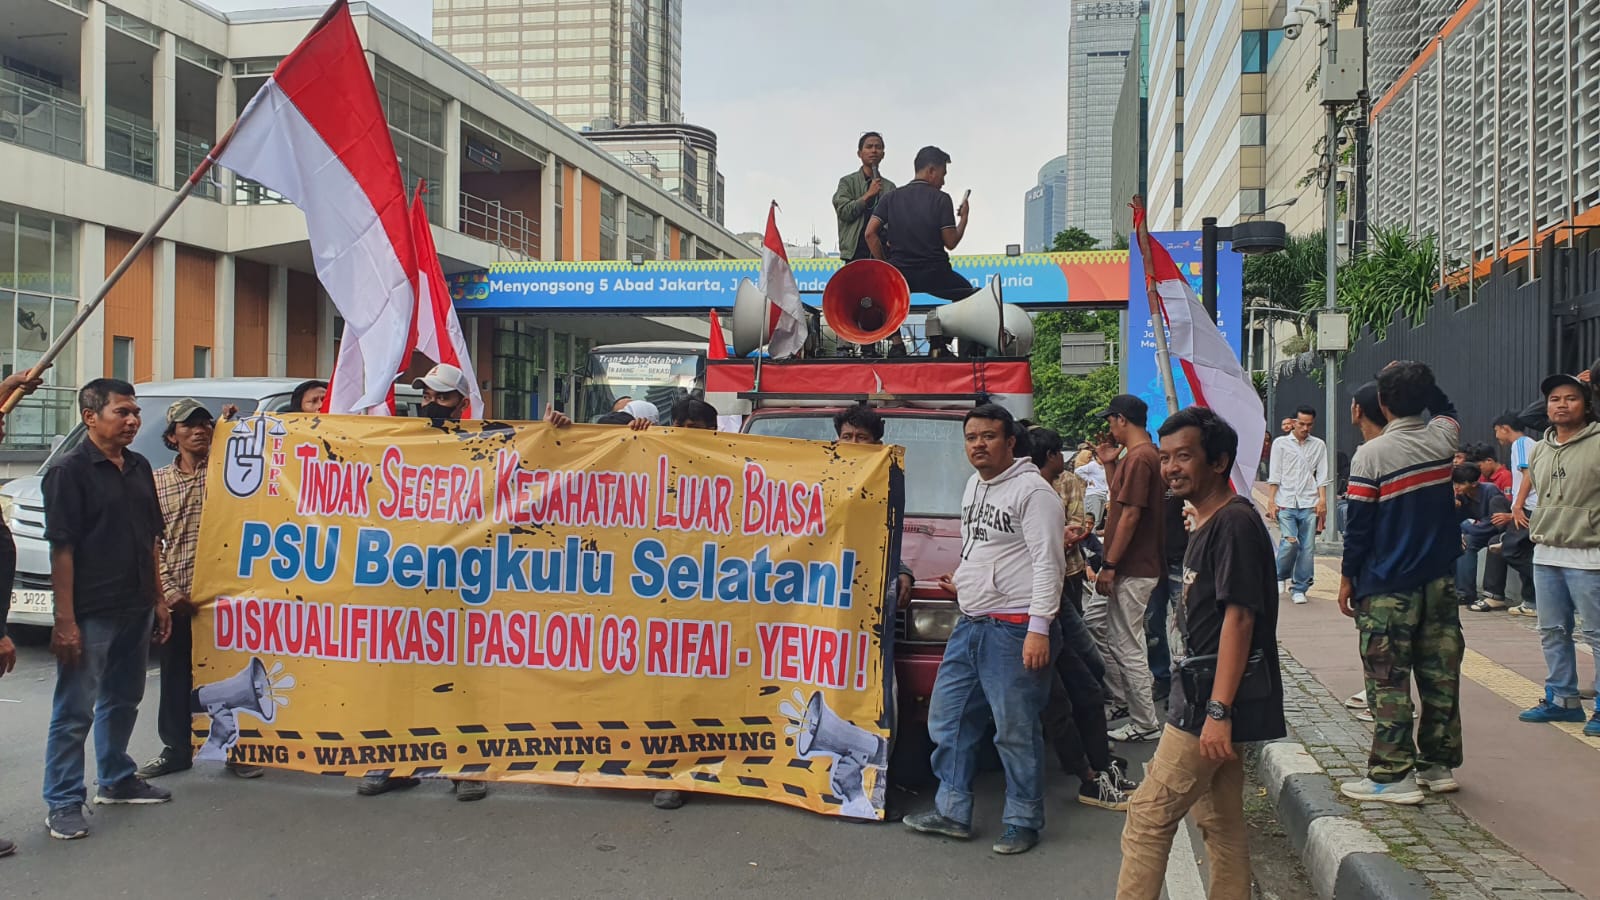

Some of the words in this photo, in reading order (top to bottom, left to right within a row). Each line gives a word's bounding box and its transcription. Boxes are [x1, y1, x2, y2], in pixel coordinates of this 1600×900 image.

[490, 278, 594, 295] Menyongsong
[599, 278, 609, 292] 5
[613, 278, 655, 292] Abad
[658, 277, 726, 294] Jakarta,
[296, 446, 370, 515] TINDAK
[379, 446, 484, 522] SEGERA
[495, 449, 649, 527] KEJAHATAN
[656, 456, 732, 534] LUAR
[743, 463, 824, 535] BIASA
[237, 522, 341, 583] PSU
[354, 529, 613, 604] Bengkulu
[630, 538, 855, 608] Selatan!
[216, 598, 457, 663] DISKUALIFIKASI
[466, 611, 592, 669] PASLON
[600, 616, 637, 673] 03
[647, 619, 730, 677] RIFAI
[313, 741, 448, 767] WARNING
[477, 735, 612, 758] WARNING
[640, 731, 777, 756] WARNING
